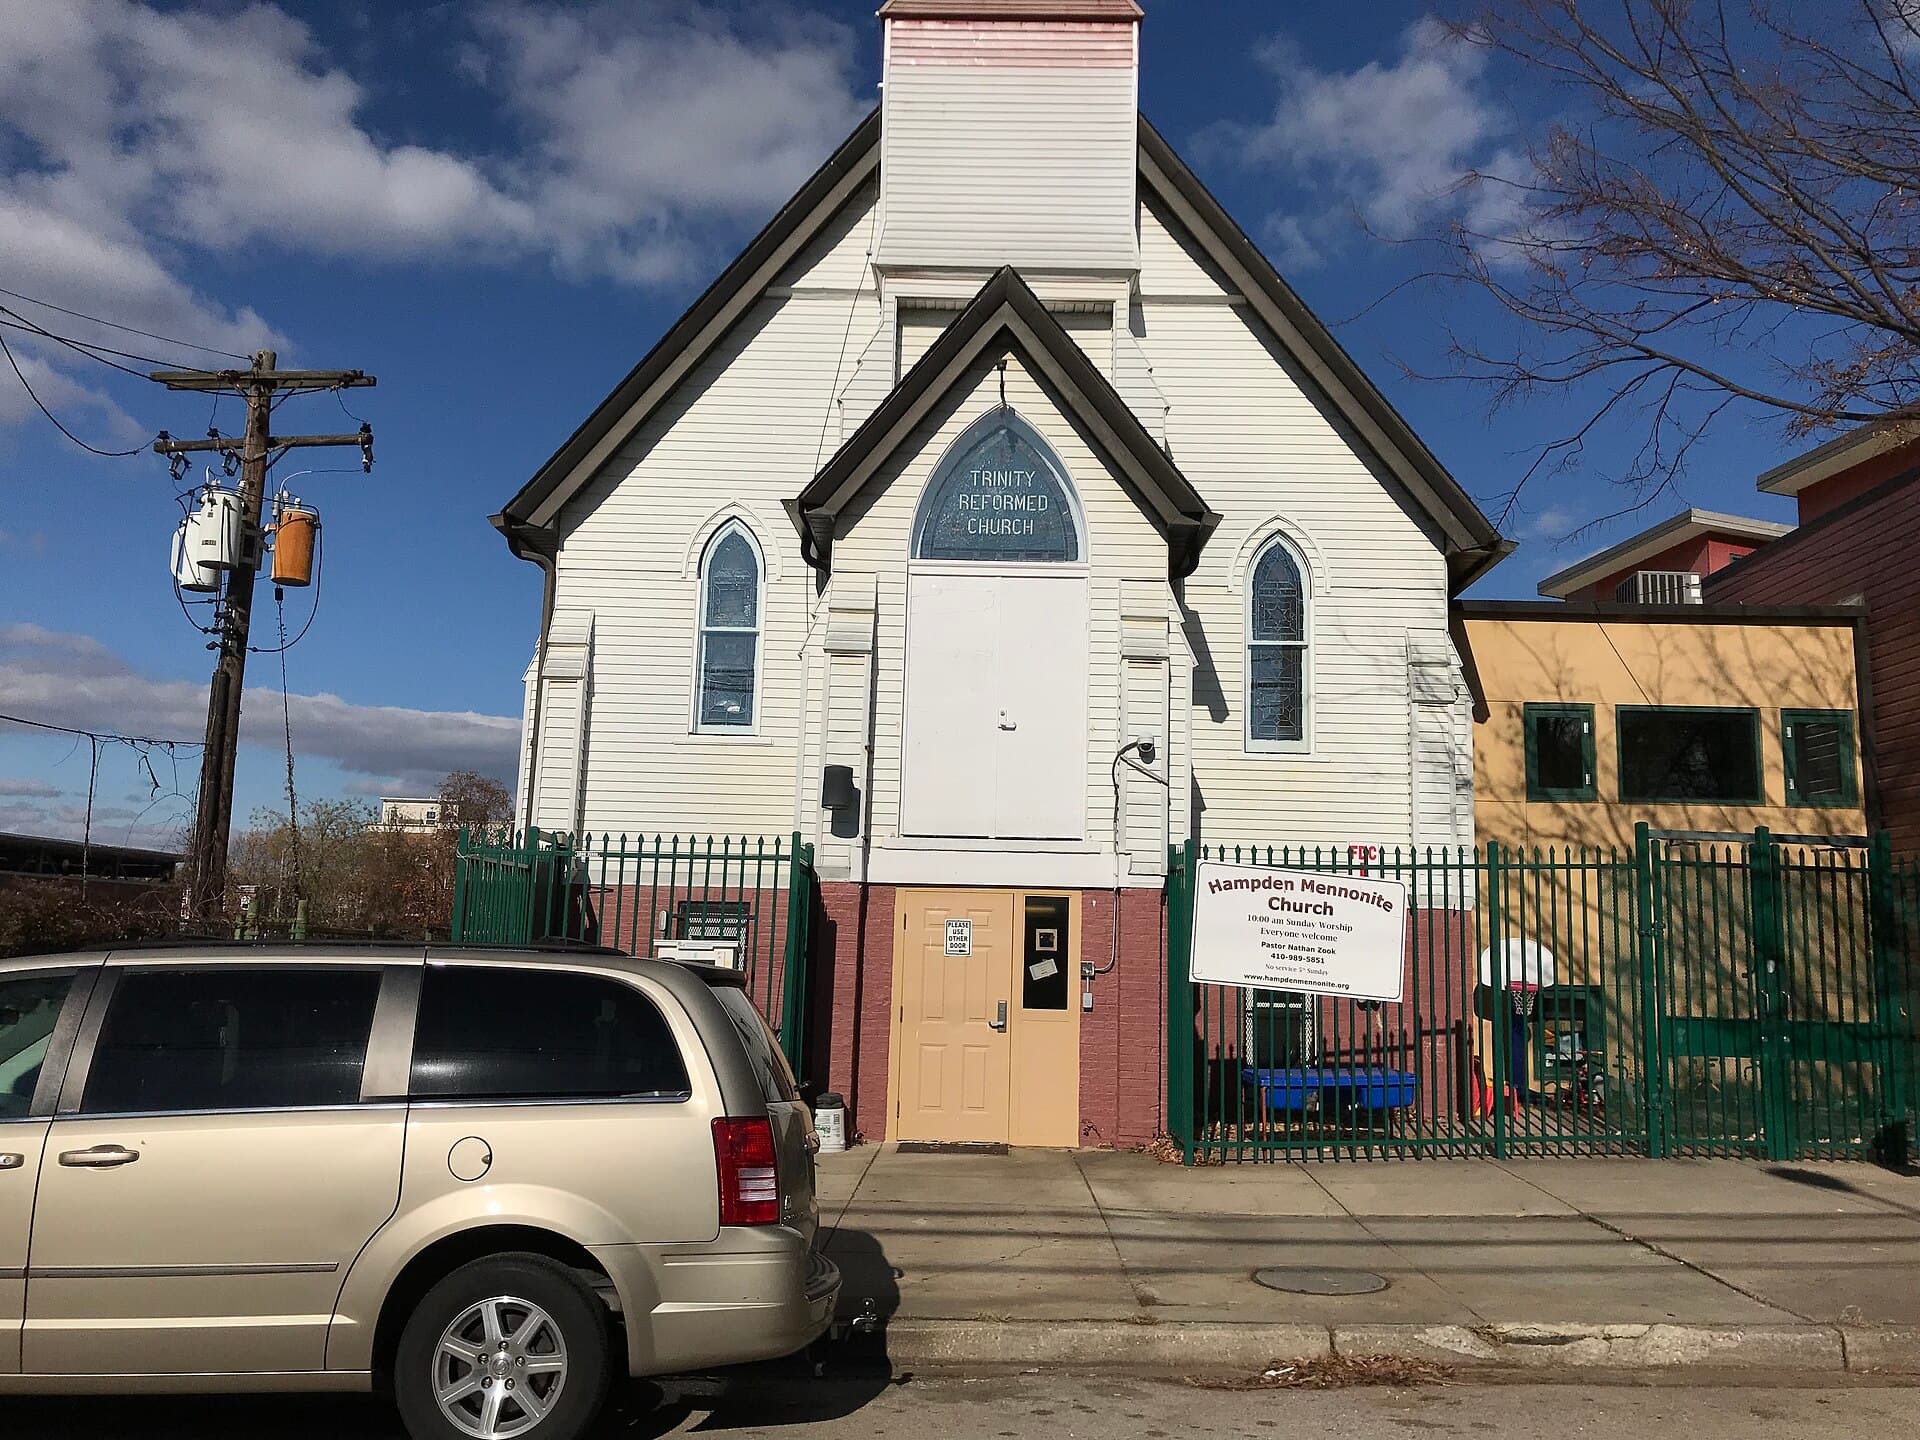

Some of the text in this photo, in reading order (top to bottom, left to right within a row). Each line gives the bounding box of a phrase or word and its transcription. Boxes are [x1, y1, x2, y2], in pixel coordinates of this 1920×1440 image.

[970, 470, 1036, 488] TRINITY
[959, 494, 1048, 511] REFORMED
[967, 518, 1034, 535] CHURCH
[1349, 845, 1377, 861] FDC
[1207, 876, 1394, 912] Hampden Mennonite
[1268, 896, 1334, 916] Church
[1286, 918, 1316, 928] Sunday
[1319, 921, 1353, 933] Worship
[1260, 927, 1338, 942] Everyone welcome
[1261, 941, 1286, 949] Pastor
[1288, 944, 1315, 952] Nathan
[1271, 953, 1325, 964] 410-989-5851
[1307, 968, 1328, 976] Sunday
[1243, 973, 1350, 990] www.hampdenmennonite.org
